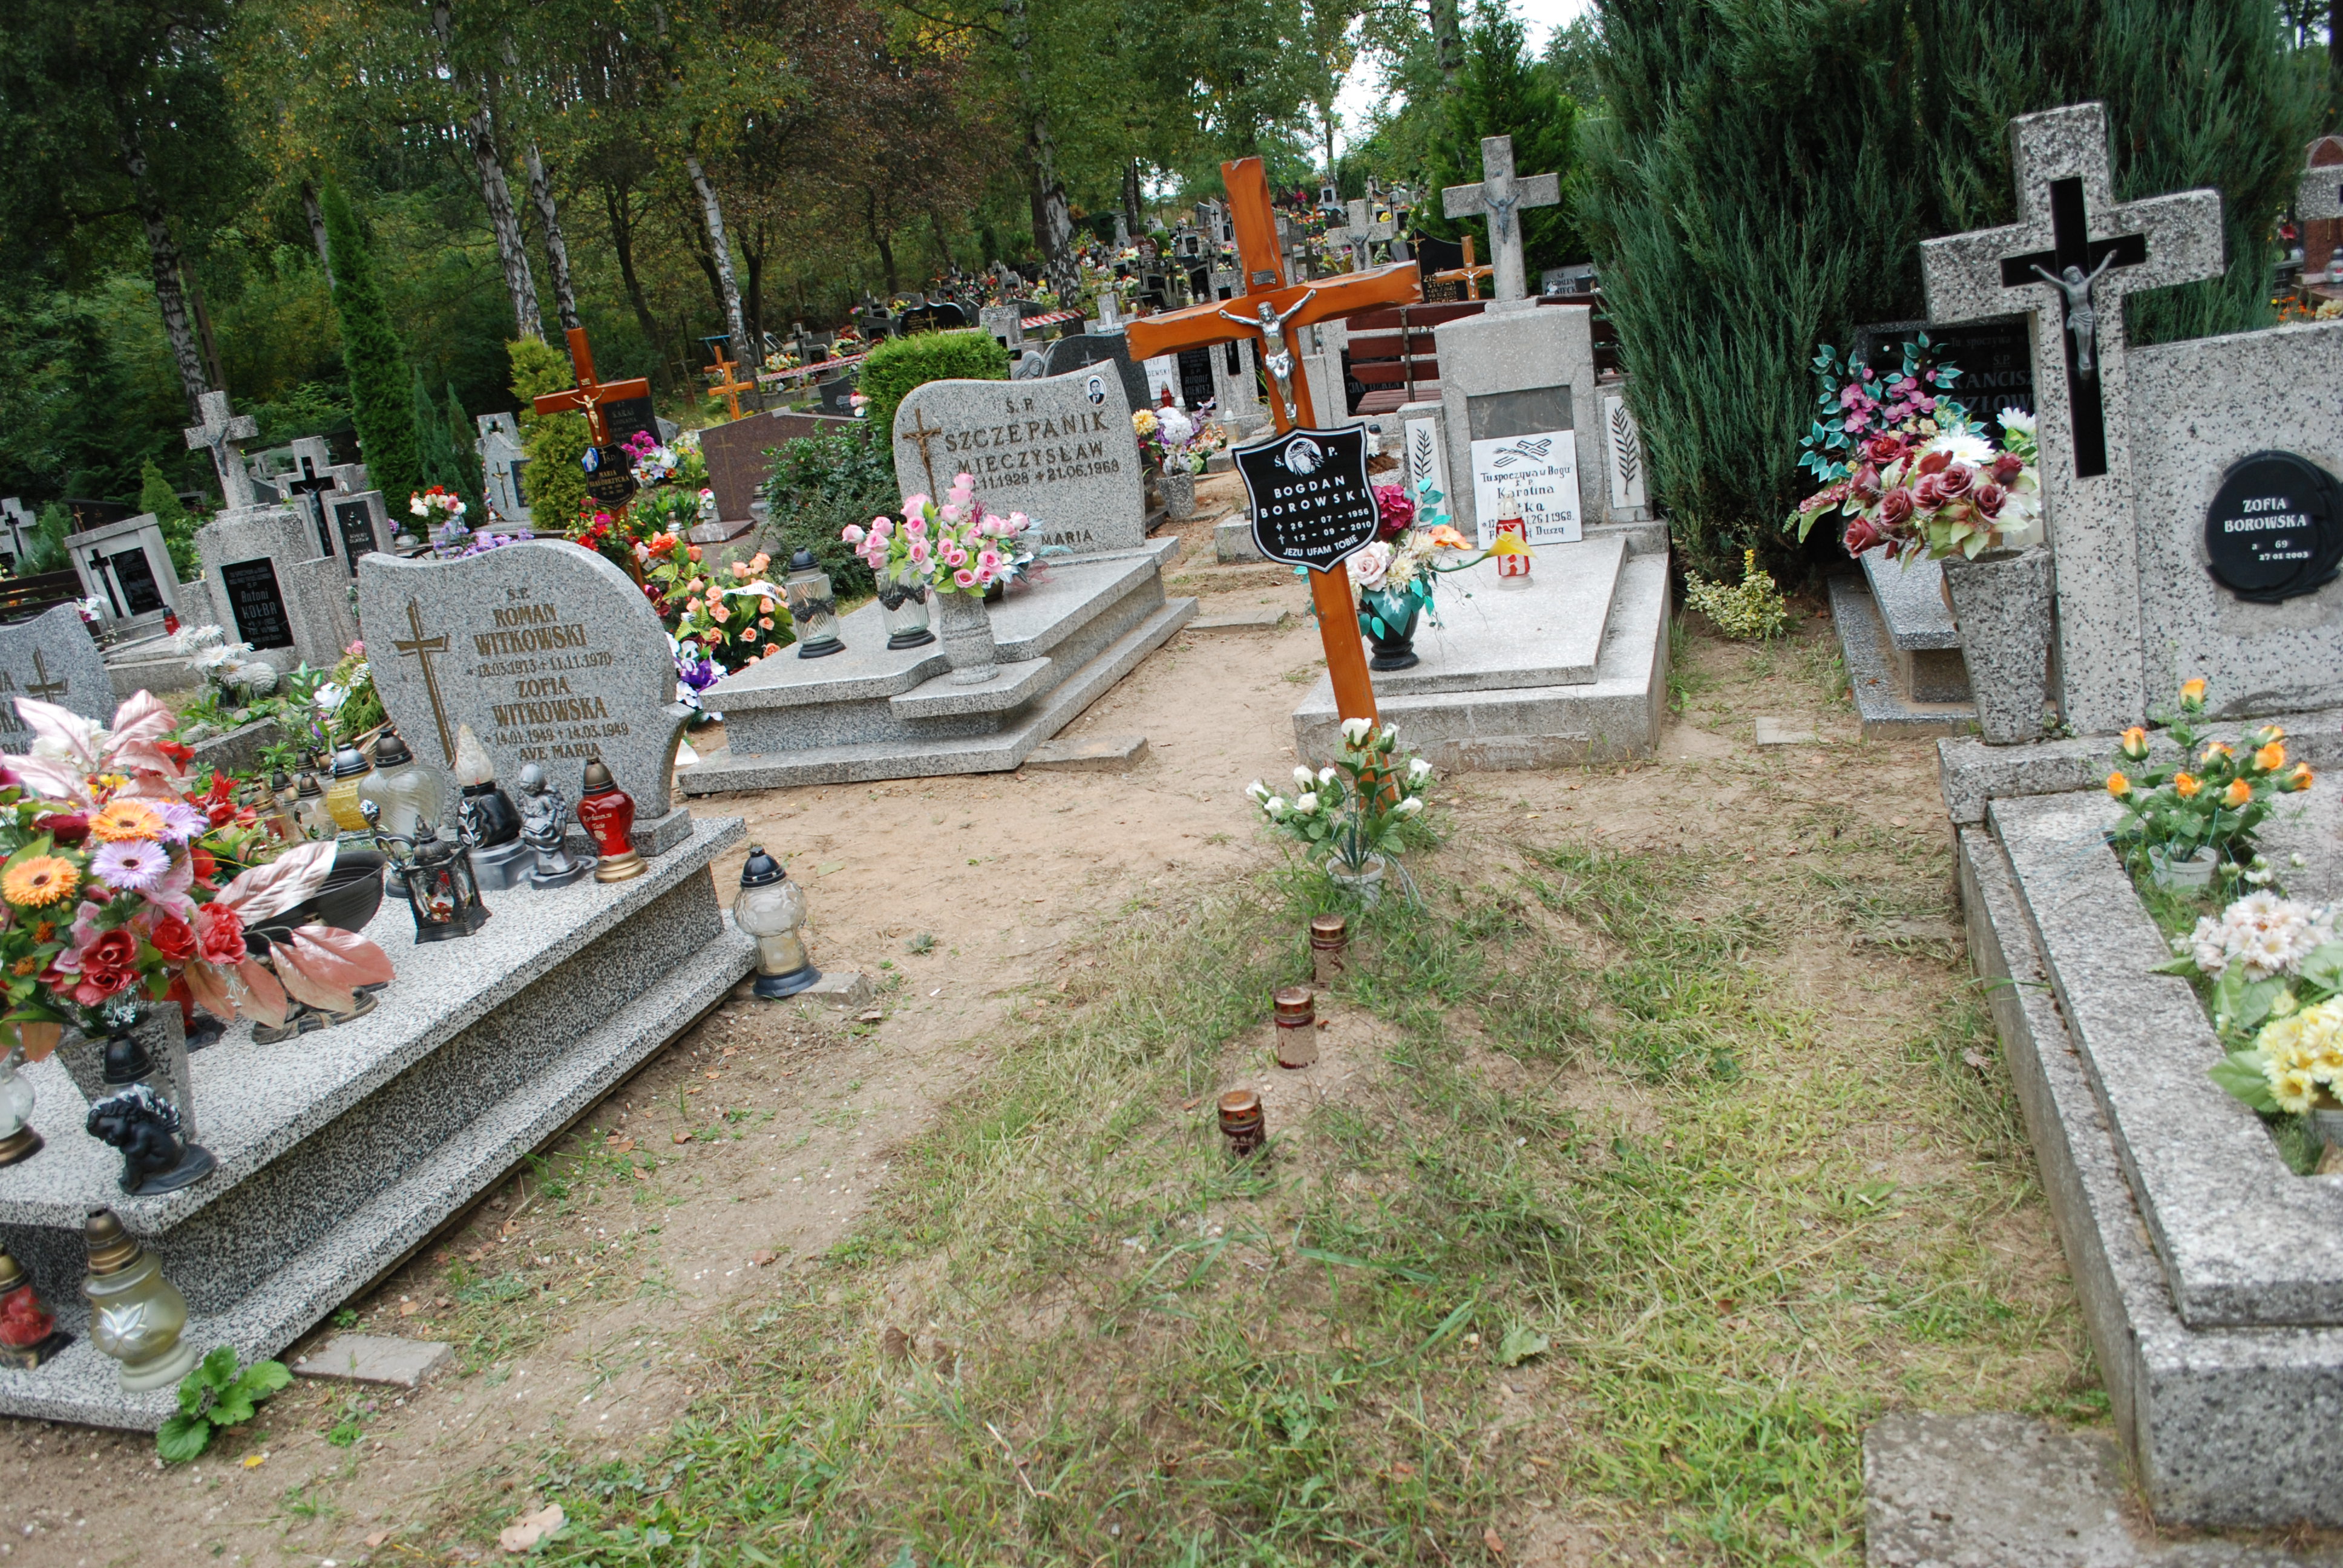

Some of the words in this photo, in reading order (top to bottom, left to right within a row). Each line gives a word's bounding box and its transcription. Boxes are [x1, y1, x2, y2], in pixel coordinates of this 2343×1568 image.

[1348, 382, 1366, 393] JAN
[945, 411, 1110, 452] SZCZEPANIK
[958, 441, 1103, 474] MIECZYSŁAW
[1274, 454, 1285, 467] Ś.
[1327, 446, 1338, 457] P.
[1047, 459, 1119, 481] 21.06.1968
[1548, 466, 1571, 479] Bogu
[1274, 475, 1345, 498] BOGDAN
[1260, 488, 1366, 518] BOROWSKI
[2243, 498, 2287, 513] ZOFIA
[1290, 521, 1303, 531] 26
[1320, 515, 1332, 524] 07
[1348, 508, 1369, 518] 1956
[2224, 514, 2307, 532] BOROWSKA
[1041, 529, 1093, 546] MARIA
[1293, 534, 1306, 542] 12
[1323, 528, 1335, 536] 09
[1350, 521, 1372, 531] 2010
[1283, 547, 1303, 557] JEZU
[1306, 544, 1332, 556] UFAM
[1334, 534, 1358, 550] TOBIE
[2275, 540, 2288, 549] 69
[2285, 551, 2309, 560] 2003
[241, 587, 269, 603] Antoni
[241, 602, 278, 619] KOŁBA
[493, 603, 558, 627] ROMAN
[473, 624, 586, 656] WITKOWSKI
[550, 652, 612, 670] 11.11.1970
[516, 676, 571, 698] ZOFIA
[491, 696, 609, 727] WITKOWSKA
[520, 746, 548, 761] AVE
[551, 742, 602, 759] MARIA
